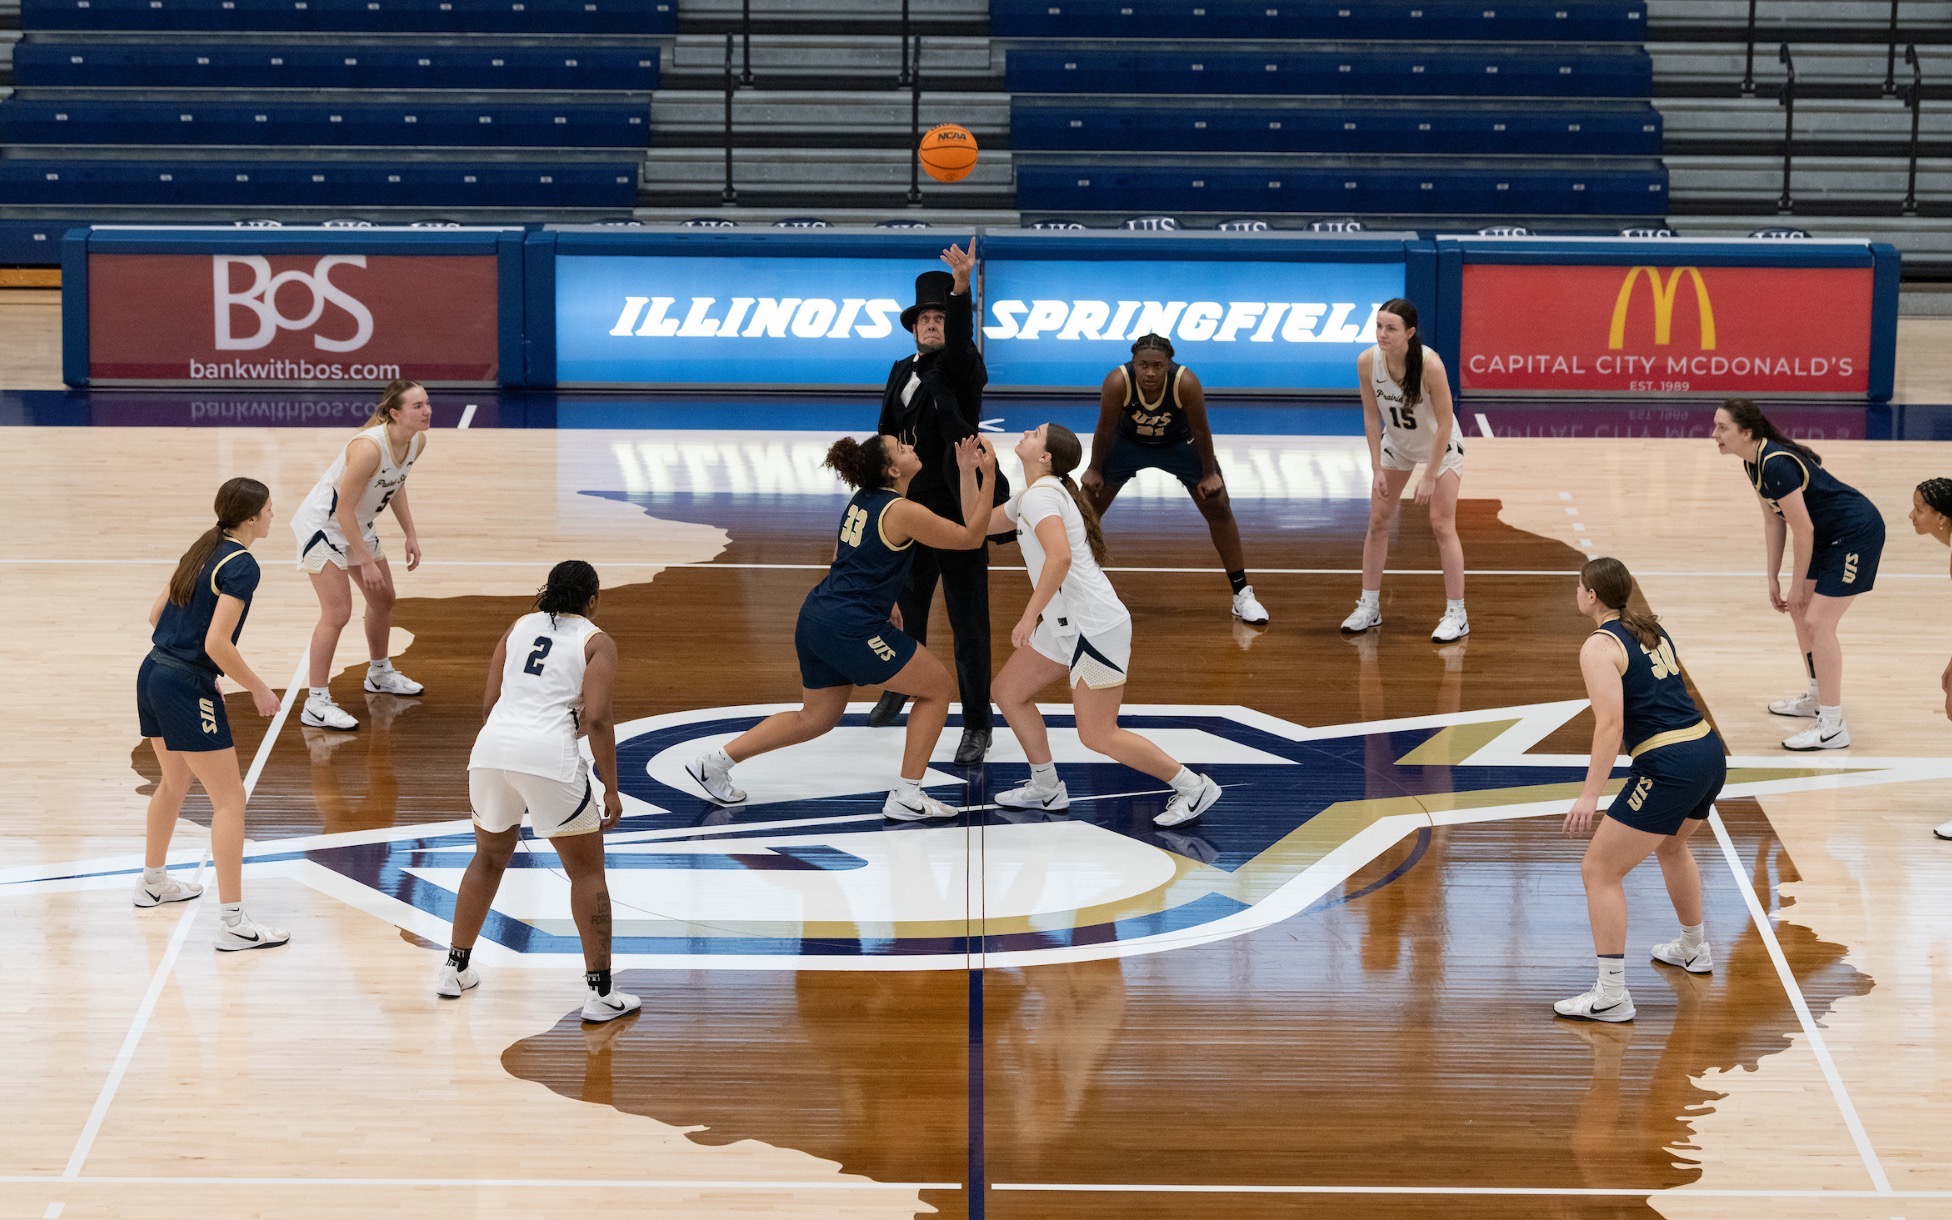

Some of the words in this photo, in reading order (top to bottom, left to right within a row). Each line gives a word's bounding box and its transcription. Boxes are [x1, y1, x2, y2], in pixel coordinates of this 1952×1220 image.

[937, 131, 967, 141] NCAA
[608, 296, 902, 339] ILLINOIS
[189, 358, 400, 379] bankwithbos.com
[1469, 355, 1586, 375] CAPITAL
[1596, 356, 1656, 375] CITY
[1629, 380, 1657, 391] EST.
[1660, 380, 1690, 392] 1989
[1131, 409, 1173, 427] UIS
[1389, 406, 1418, 430] 15
[375, 489, 396, 513] 5
[839, 504, 868, 548] 33
[1842, 552, 1859, 584] UIS
[523, 635, 553, 677] 2
[867, 635, 896, 663] UIS
[1639, 635, 1680, 680] 30
[199, 697, 218, 735] UIS
[1627, 775, 1654, 812] UIS
